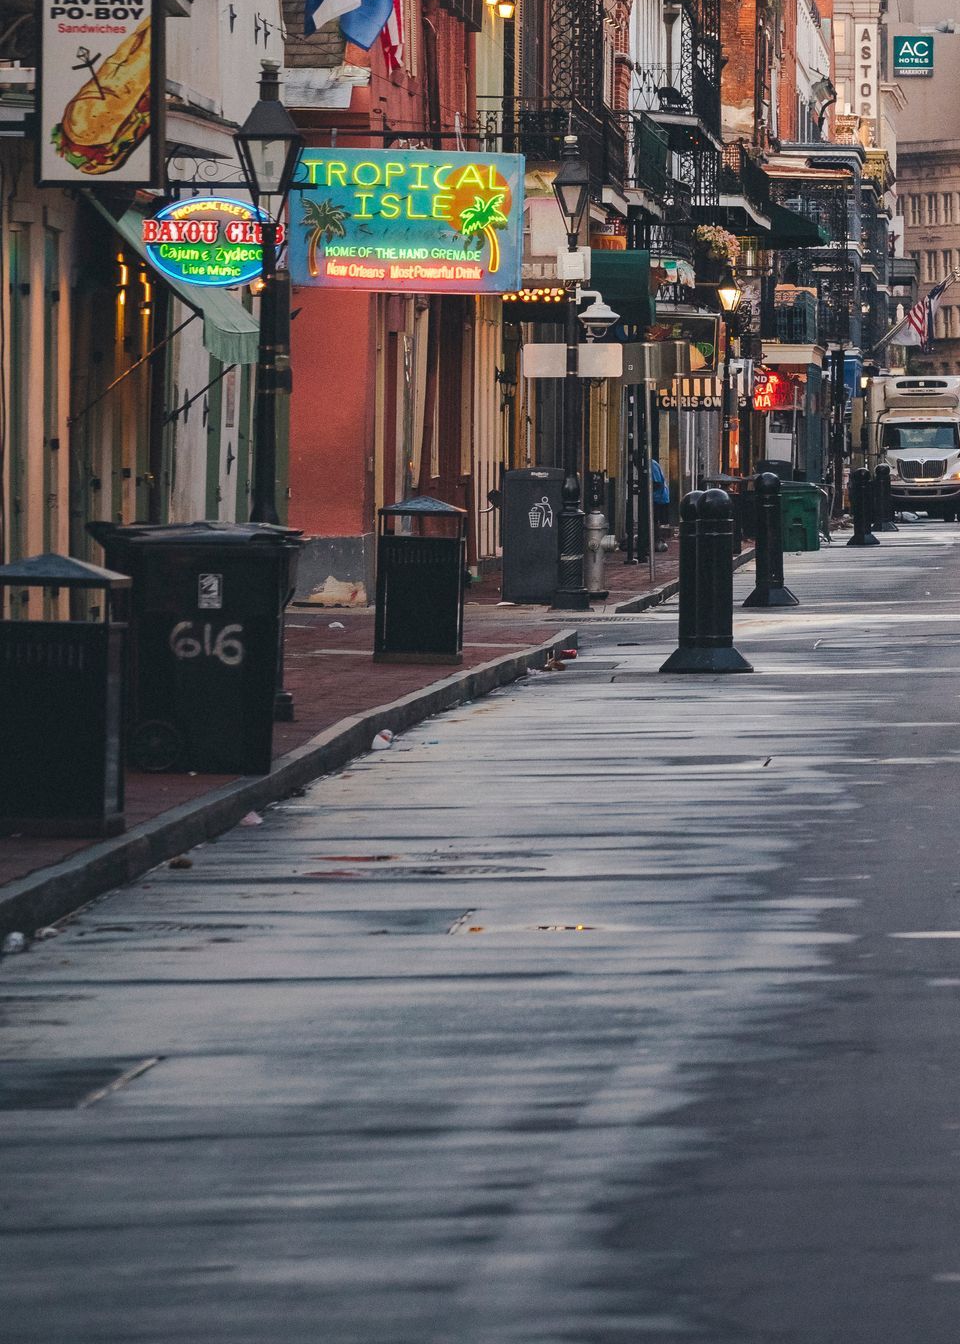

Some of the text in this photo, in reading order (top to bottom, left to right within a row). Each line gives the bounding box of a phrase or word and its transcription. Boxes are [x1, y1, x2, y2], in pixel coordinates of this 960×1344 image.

[50, 7, 144, 20] PO-BOY
[58, 23, 127, 34] Sandwiches
[899, 41, 929, 57] AC
[860, 28, 872, 116] ASTOR
[305, 160, 508, 191] TROPICAL
[171, 202, 252, 220] TROPICAL ISLE'S
[353, 193, 455, 220] ISLE
[142, 220, 219, 244] BAYOU
[160, 244, 199, 261] Cajun
[325, 246, 482, 262] HOME OF THE HAND GRENADE
[182, 264, 242, 277] Live Music
[327, 261, 483, 281] New Orleans Most Powerful Drink
[703, 396, 748, 408] OWS
[169, 621, 244, 665] 616
